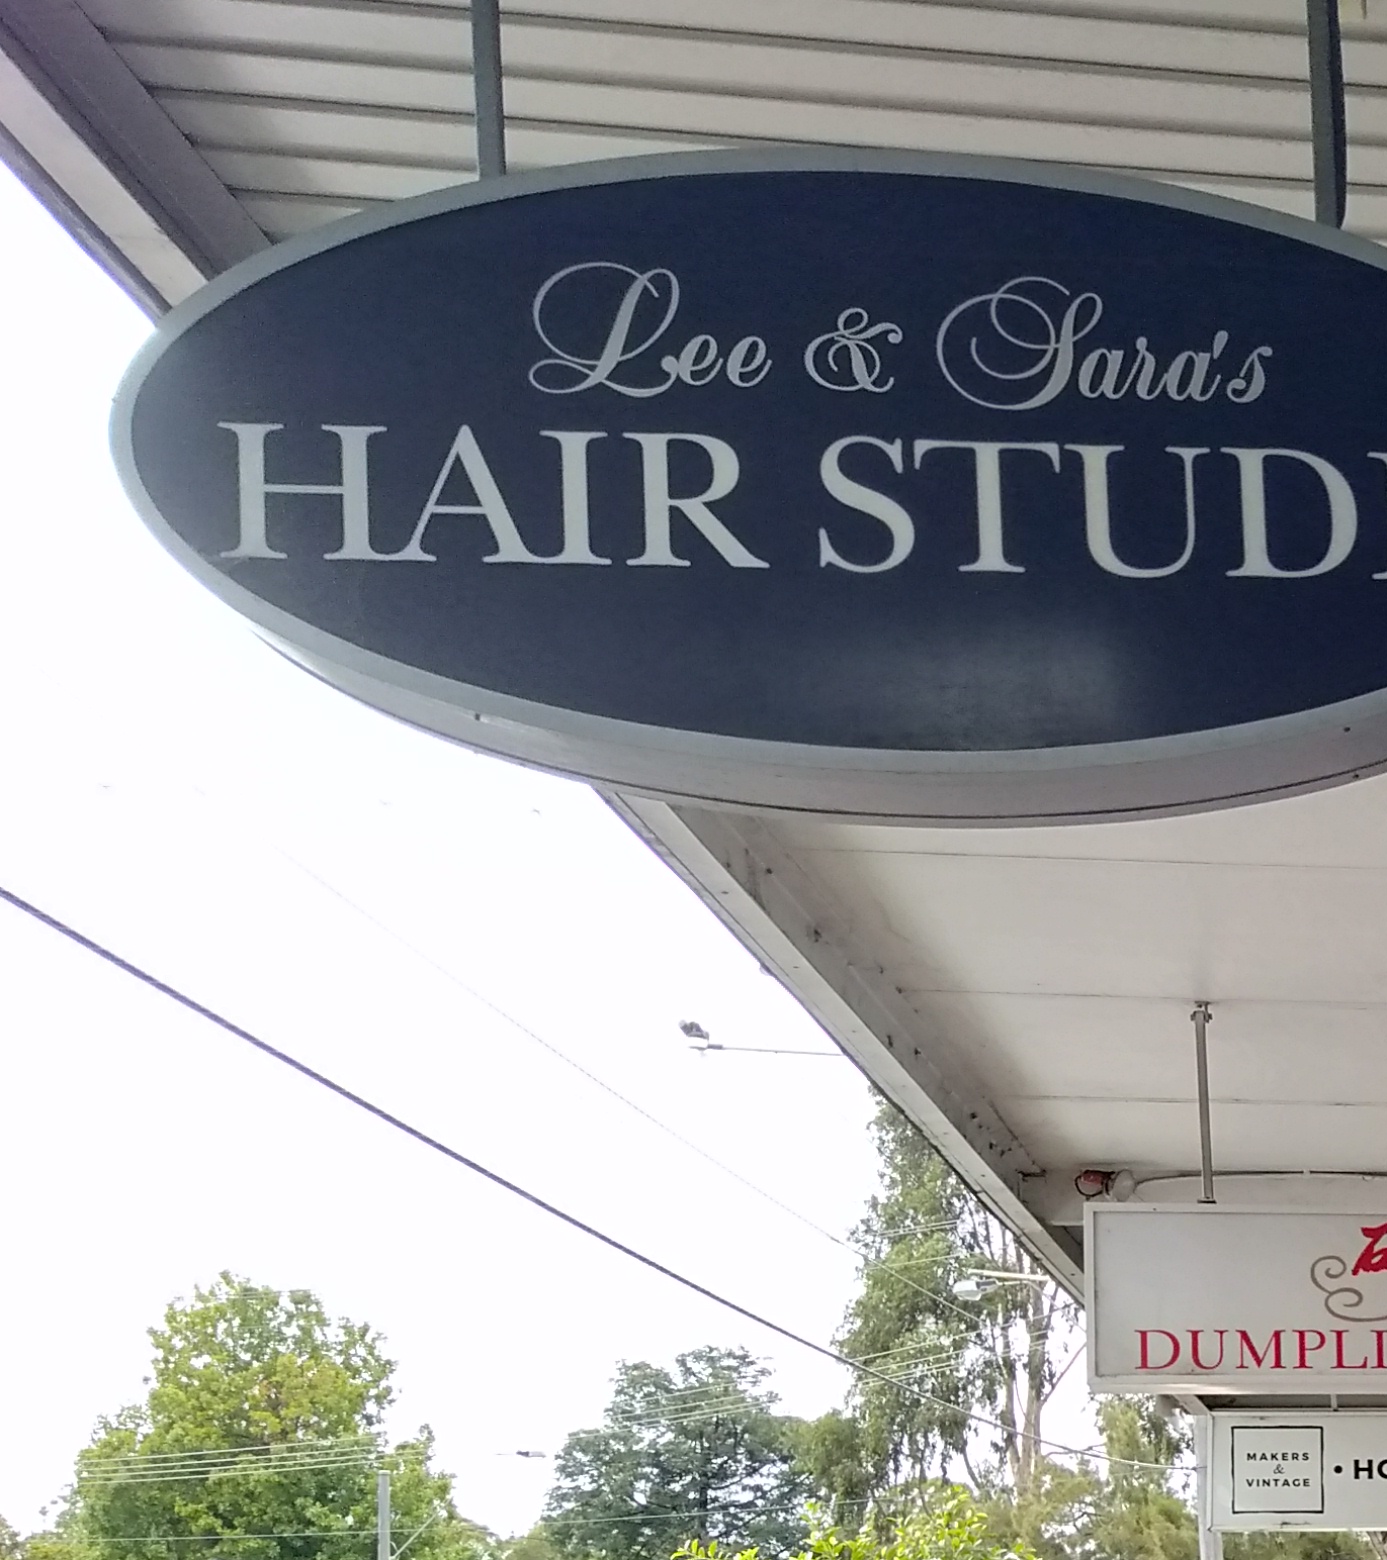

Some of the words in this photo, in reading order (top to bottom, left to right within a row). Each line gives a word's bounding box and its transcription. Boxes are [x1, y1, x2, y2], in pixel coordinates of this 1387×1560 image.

[529, 261, 774, 398] Lee
[804, 308, 903, 394] &
[937, 275, 1275, 411] Sara's
[217, 420, 769, 570] HAIR
[1246, 1451, 1311, 1462] MAKERS
[1273, 1464, 1286, 1475] &
[1246, 1477, 1312, 1488] VINTAGE
